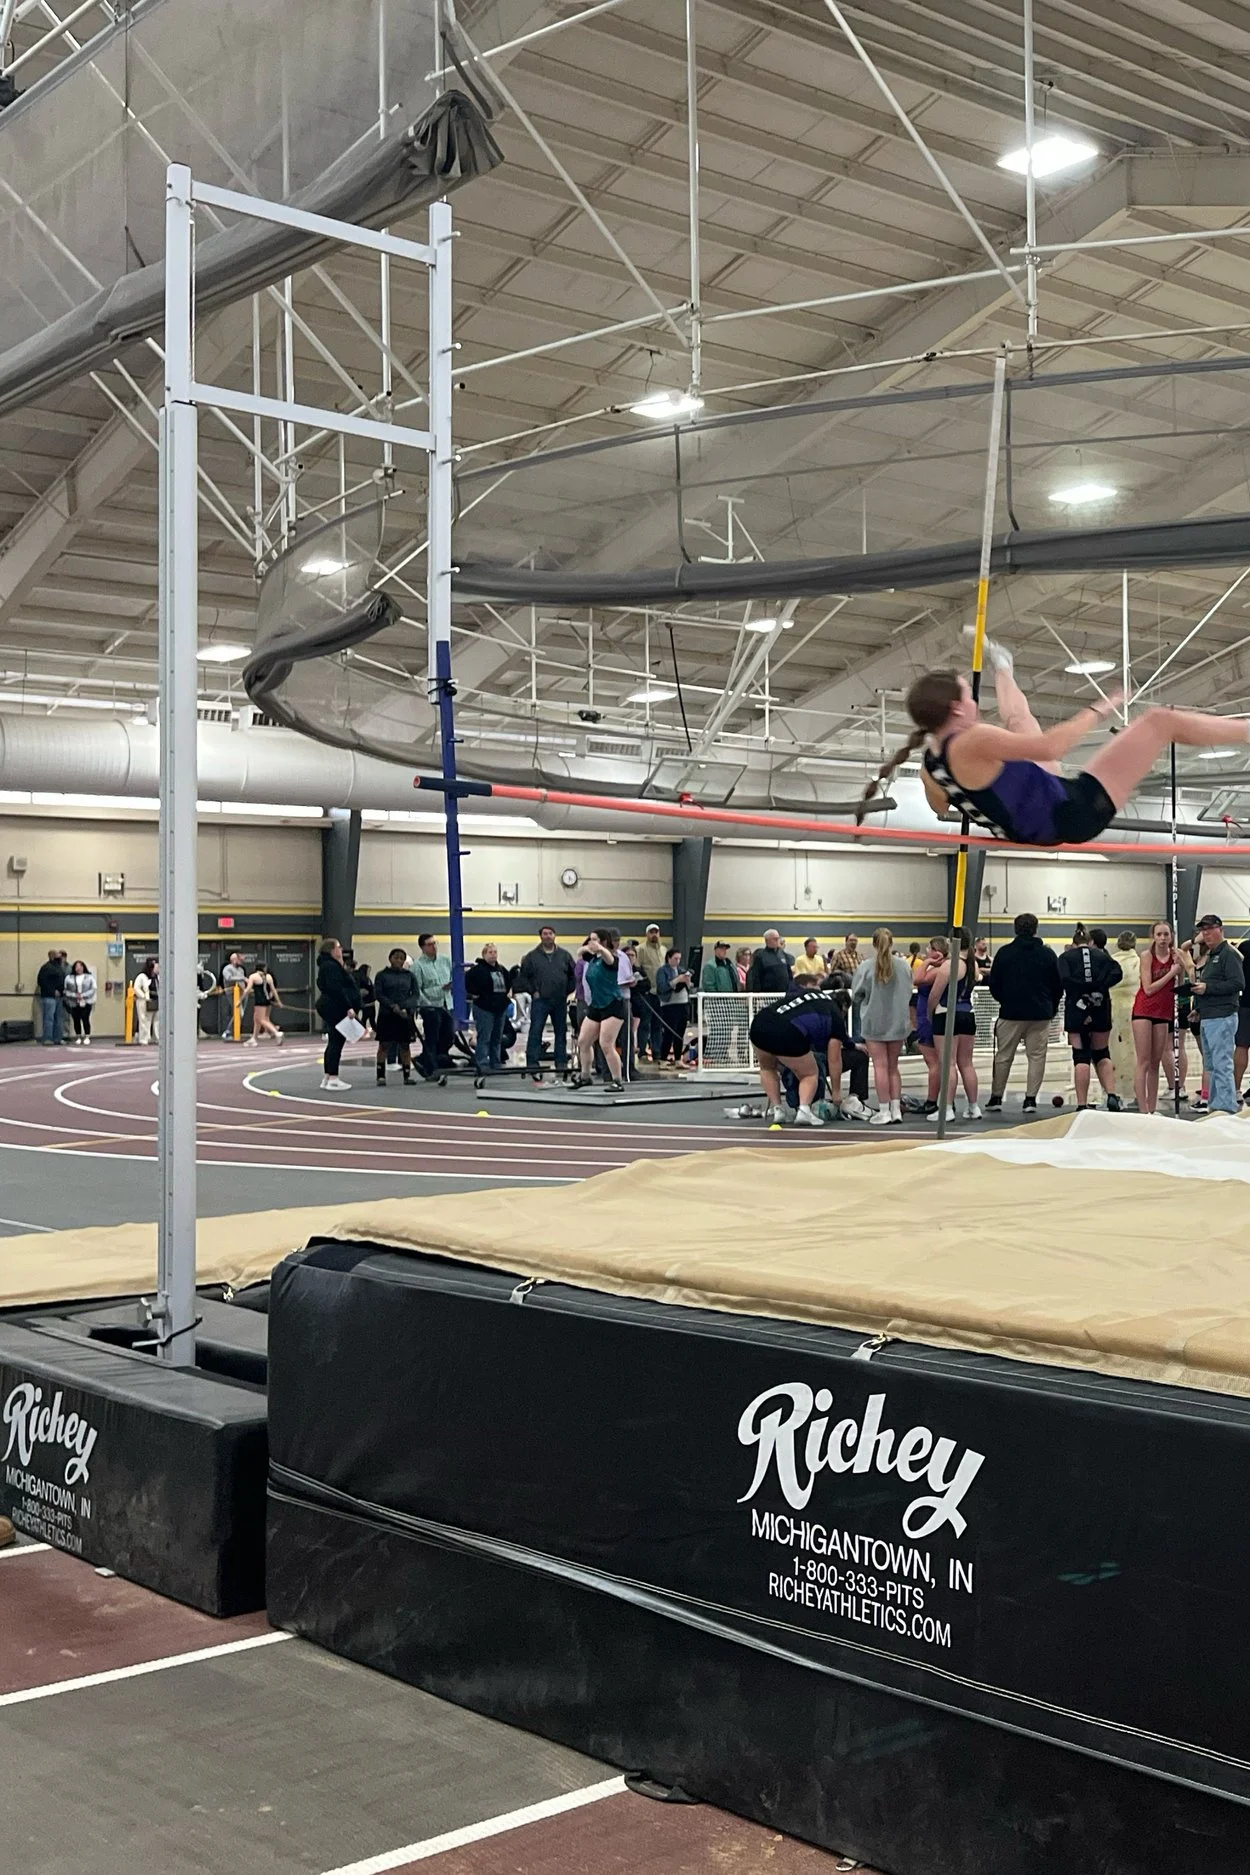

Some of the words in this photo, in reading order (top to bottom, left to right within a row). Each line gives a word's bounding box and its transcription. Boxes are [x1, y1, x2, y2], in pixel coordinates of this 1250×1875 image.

[1, 1382, 98, 1485] Richey
[737, 1382, 985, 1539] Richey
[6, 1465, 77, 1517] MICHIGANTOWN,
[81, 1497, 91, 1519] IN
[21, 1497, 72, 1530] 1-800-333-PITS
[12, 1507, 82, 1554] RICHEYATHLETICS.COM
[751, 1509, 936, 1588] MICHIGANTOWN,
[949, 1558, 973, 1593] IN
[769, 1572, 951, 1648] RICHEYATHLETICS.COM
[793, 1556, 924, 1609] 1-800-333-PITS
